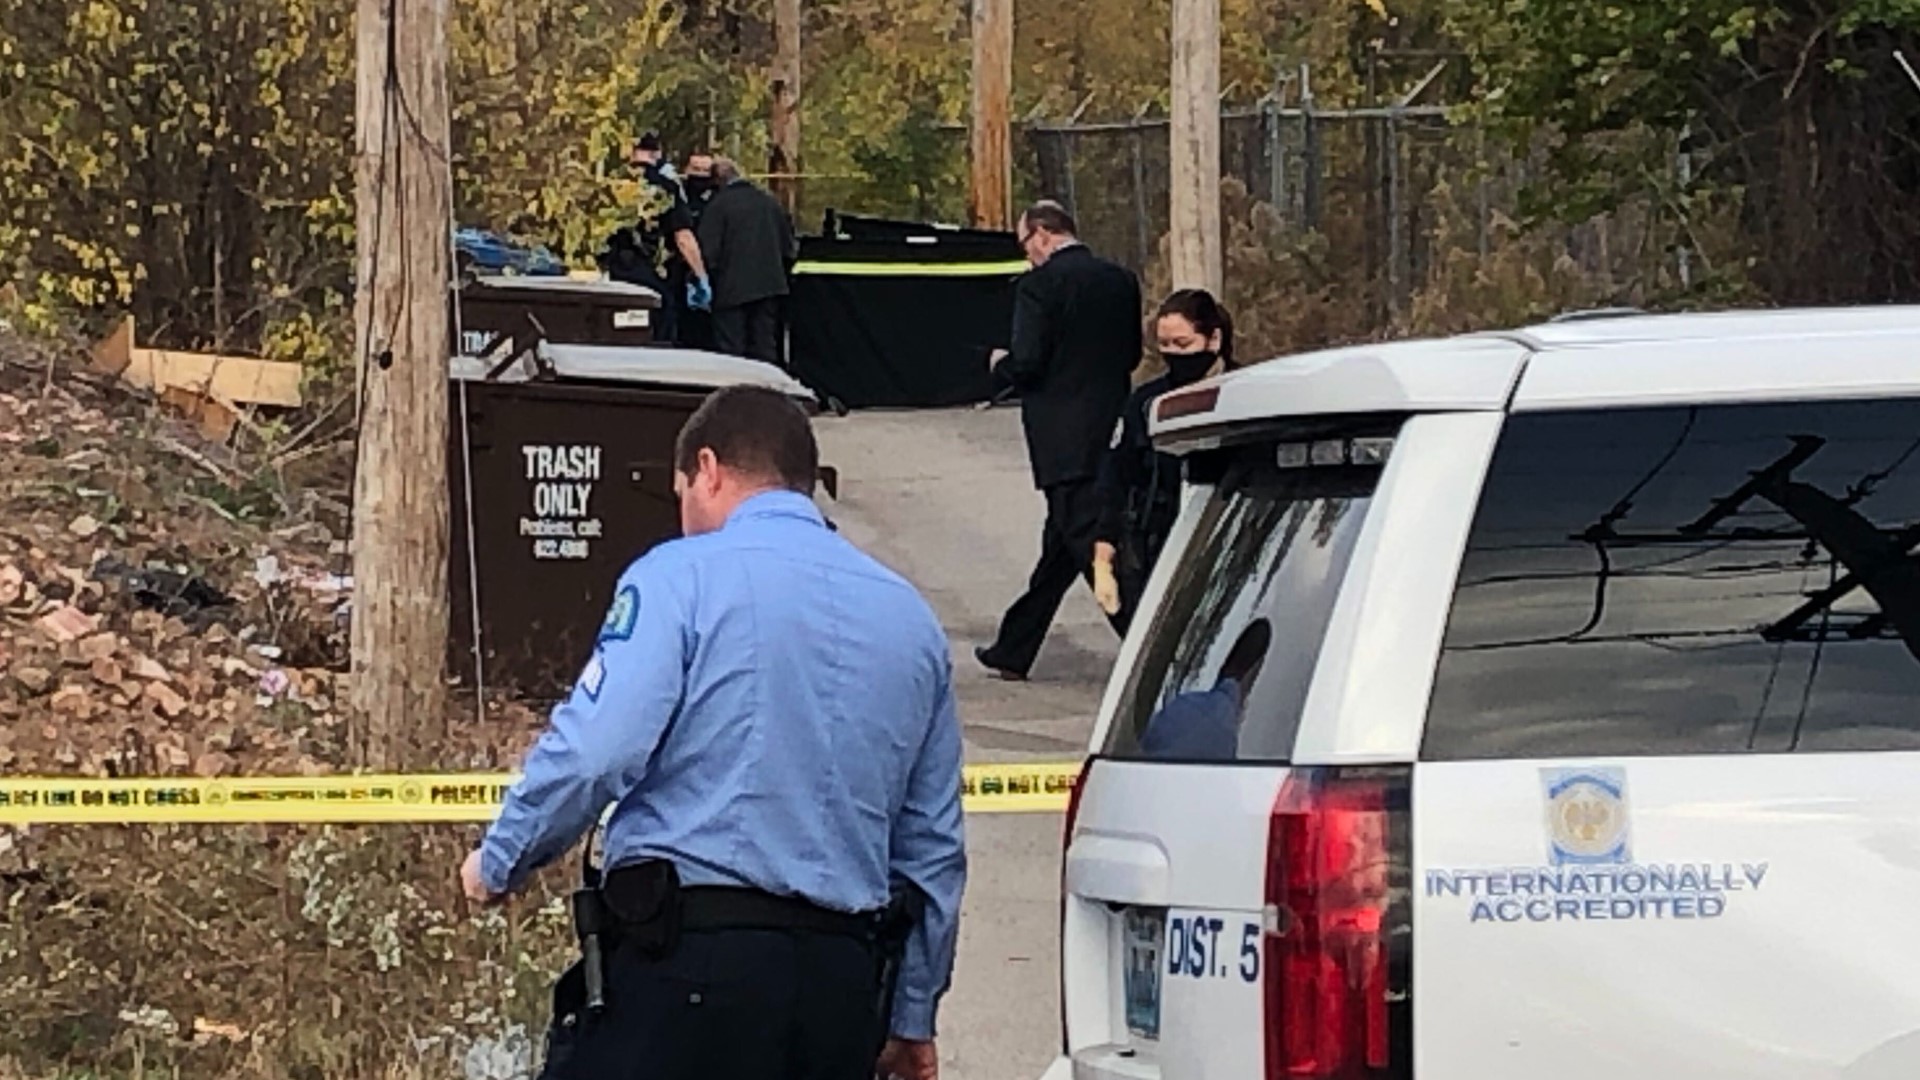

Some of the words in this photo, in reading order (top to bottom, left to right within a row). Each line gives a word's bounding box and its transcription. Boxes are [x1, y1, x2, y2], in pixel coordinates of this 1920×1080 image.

[522, 445, 601, 479] TRASH
[534, 482, 592, 517] ONLY
[431, 784, 487, 804] POLICE
[1425, 862, 1769, 898] INTERNATIONALLY
[1470, 894, 1727, 923] ACCREDITED
[1168, 916, 1226, 978] DIST.
[1239, 923, 1261, 983] 5
